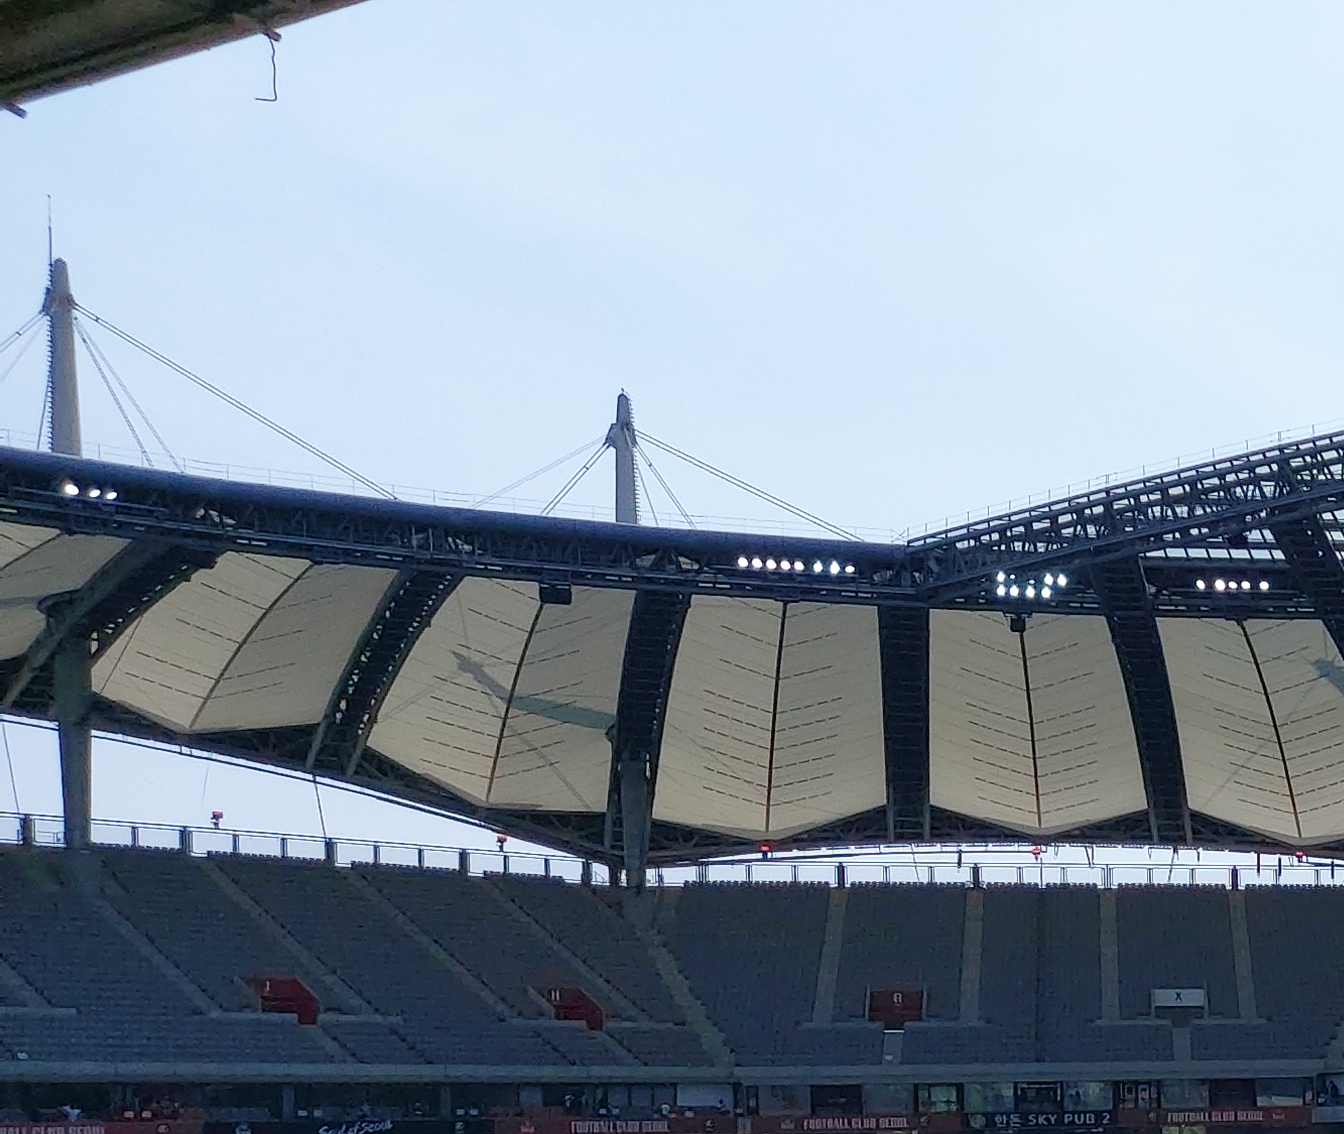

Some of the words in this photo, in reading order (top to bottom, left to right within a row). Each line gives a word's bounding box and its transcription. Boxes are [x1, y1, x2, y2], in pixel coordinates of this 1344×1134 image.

[1175, 992, 1182, 1002] X
[1028, 1112, 1058, 1126] SKY
[1064, 1112, 1095, 1125] PUB
[1102, 1112, 1111, 1124] 2
[359, 1120, 393, 1134] Seoul
